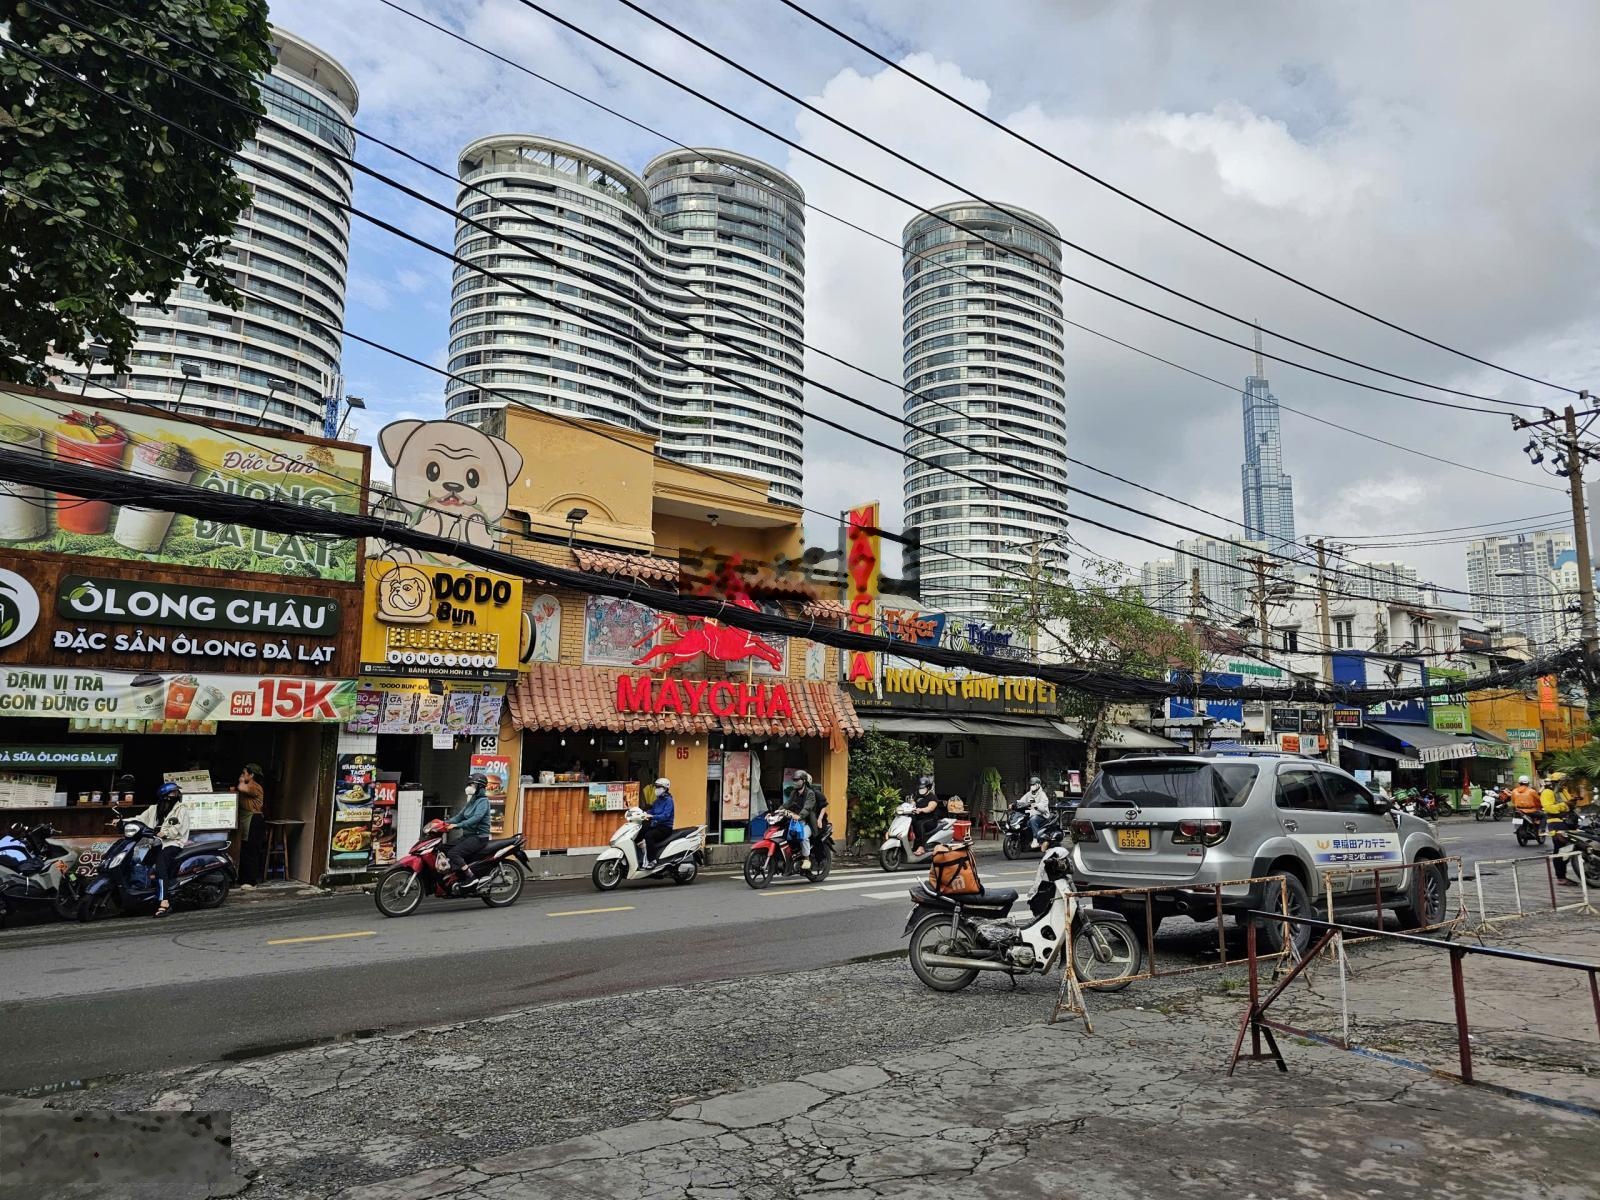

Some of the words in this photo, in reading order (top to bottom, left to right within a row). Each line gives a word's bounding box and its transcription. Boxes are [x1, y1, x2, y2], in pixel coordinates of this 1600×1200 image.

[223, 451, 264, 474] Đặc
[70, 581, 216, 622] ÔLONG
[226, 598, 326, 629] CHÂU
[848, 504, 875, 683] MAYCA
[389, 627, 496, 651] BURGER
[885, 609, 938, 645] Tiger
[53, 627, 108, 654] ĐẶC
[114, 629, 166, 652] SẢN
[171, 633, 257, 658] ÔLONG
[262, 640, 292, 660] ĐÀ
[298, 645, 336, 666] LẠT
[94, 697, 119, 713] GU
[257, 679, 338, 719] 15K
[616, 675, 793, 719] MAYCHA
[480, 736, 496, 748] 63
[676, 747, 689, 760] 65
[36, 751, 79, 762] ÔLONG
[1126, 830, 1140, 838] 51F
